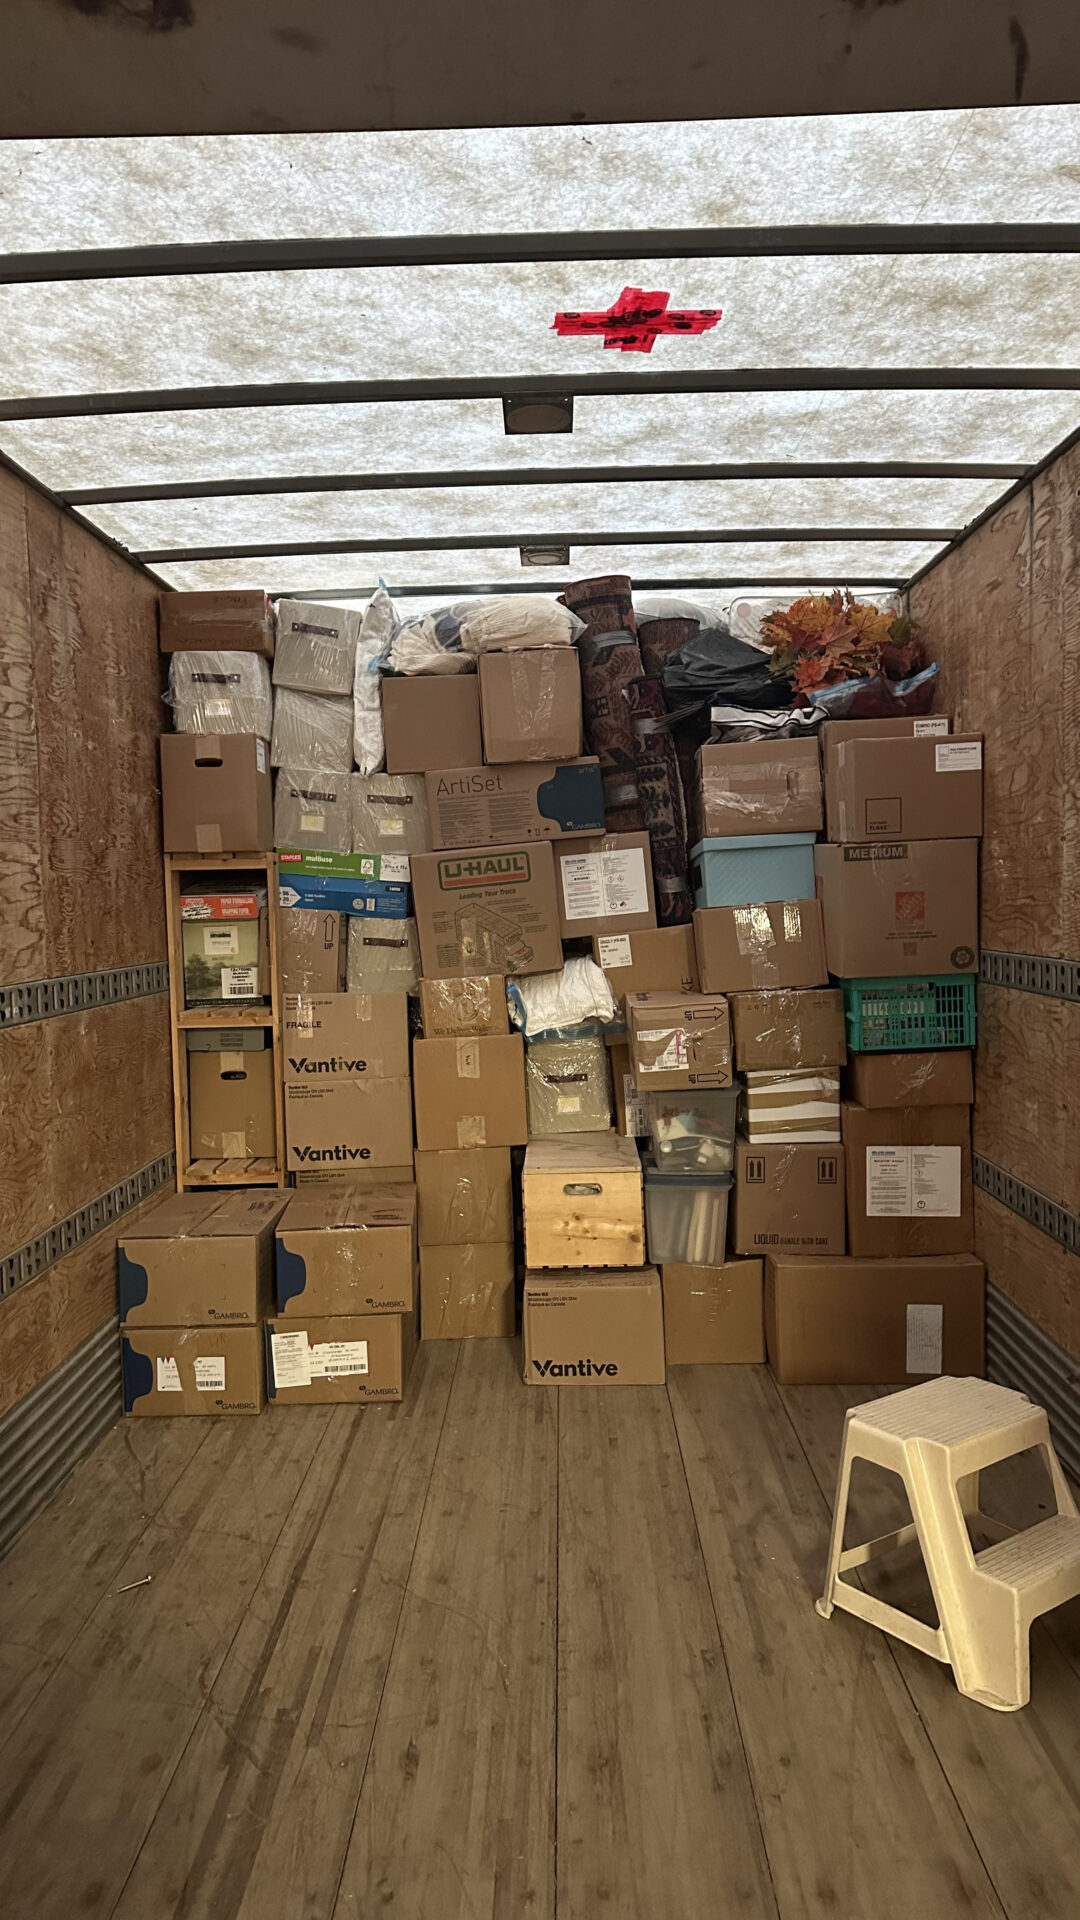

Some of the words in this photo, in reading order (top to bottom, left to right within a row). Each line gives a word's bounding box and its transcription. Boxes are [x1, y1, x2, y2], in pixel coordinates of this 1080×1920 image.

[436, 774, 503, 797] ArtiSet
[306, 855, 333, 863] multiuse
[850, 846, 903, 859] MEDIUM
[444, 857, 524, 878] U-HAUL
[459, 891, 482, 900] Loading
[684, 1010, 692, 1021] UP
[286, 1021, 322, 1029] FRAGILE
[288, 1057, 367, 1074] Vantive
[688, 1074, 697, 1084] UP
[292, 1144, 371, 1162] Vantive
[754, 1233, 779, 1245] LIQUID
[815, 1237, 828, 1246] CARE
[532, 1358, 618, 1377] Vantive
